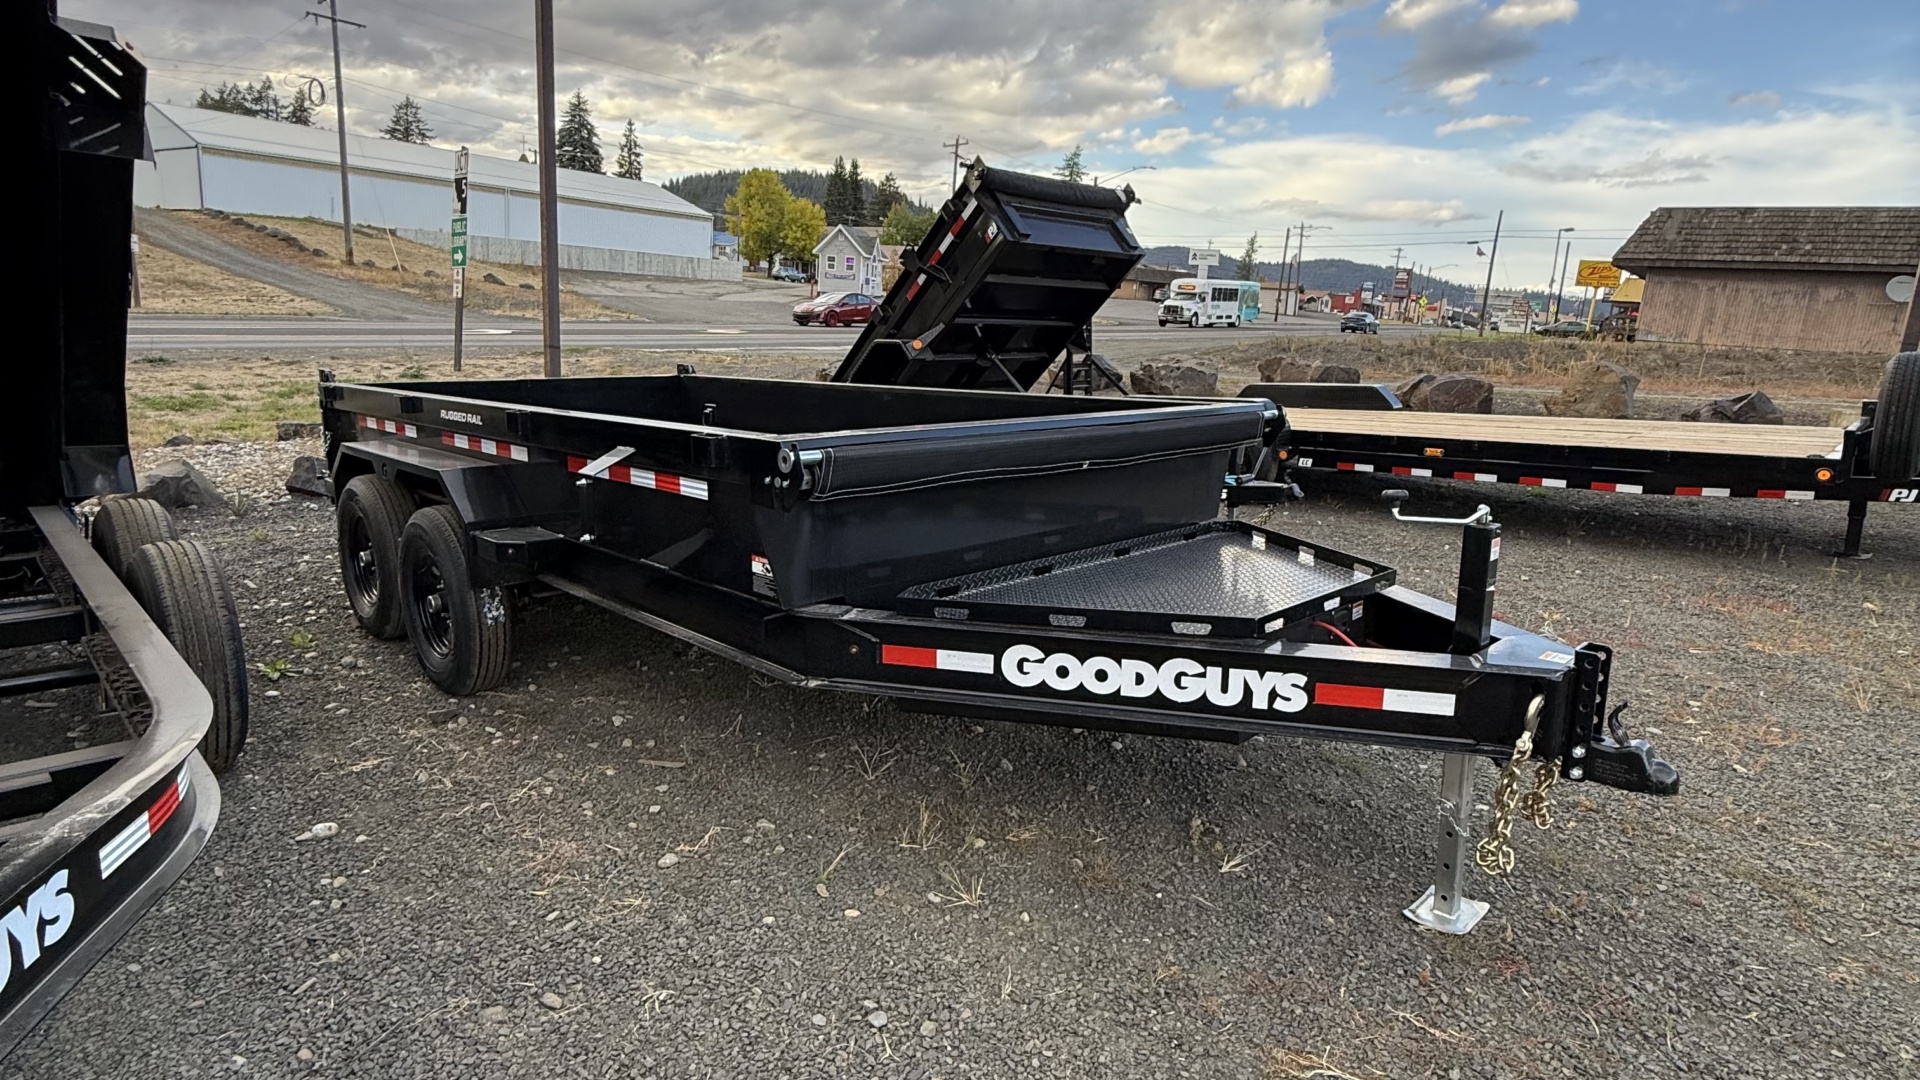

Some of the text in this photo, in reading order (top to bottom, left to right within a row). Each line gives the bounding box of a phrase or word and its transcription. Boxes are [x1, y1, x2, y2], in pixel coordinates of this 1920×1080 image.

[455, 152, 468, 172] JCT
[462, 180, 467, 198] 5
[453, 220, 467, 233] PUBLIC
[440, 409, 483, 426] RUGGED RAIL
[1888, 488, 1919, 502] PJ
[1001, 644, 1308, 713] GOODGUYS
